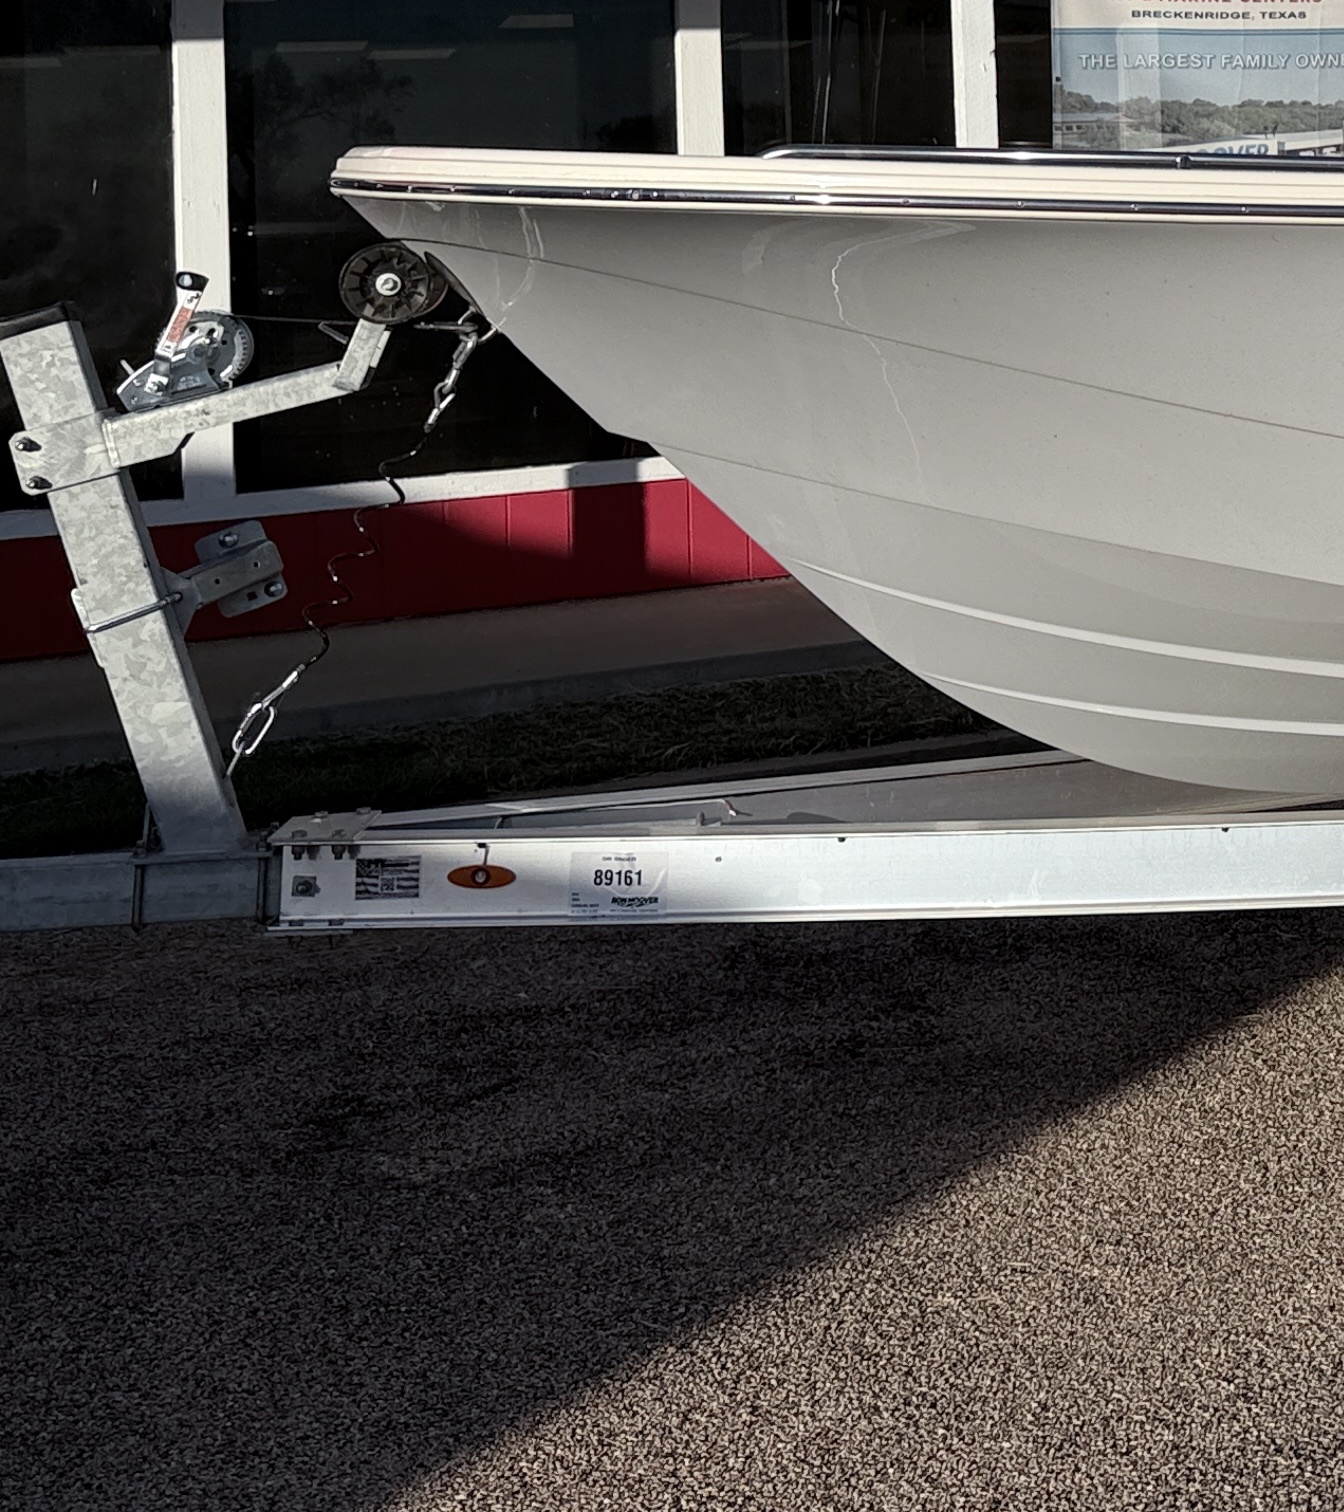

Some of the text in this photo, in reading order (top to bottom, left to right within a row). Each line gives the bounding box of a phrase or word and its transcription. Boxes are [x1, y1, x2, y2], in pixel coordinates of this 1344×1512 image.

[1131, 10, 1307, 21] BRECKENRIDGE, TEXAS
[1078, 54, 1118, 69] THE
[1124, 53, 1215, 70] LARGEST
[1221, 53, 1290, 70] FAMILY
[593, 869, 642, 887] 89161
